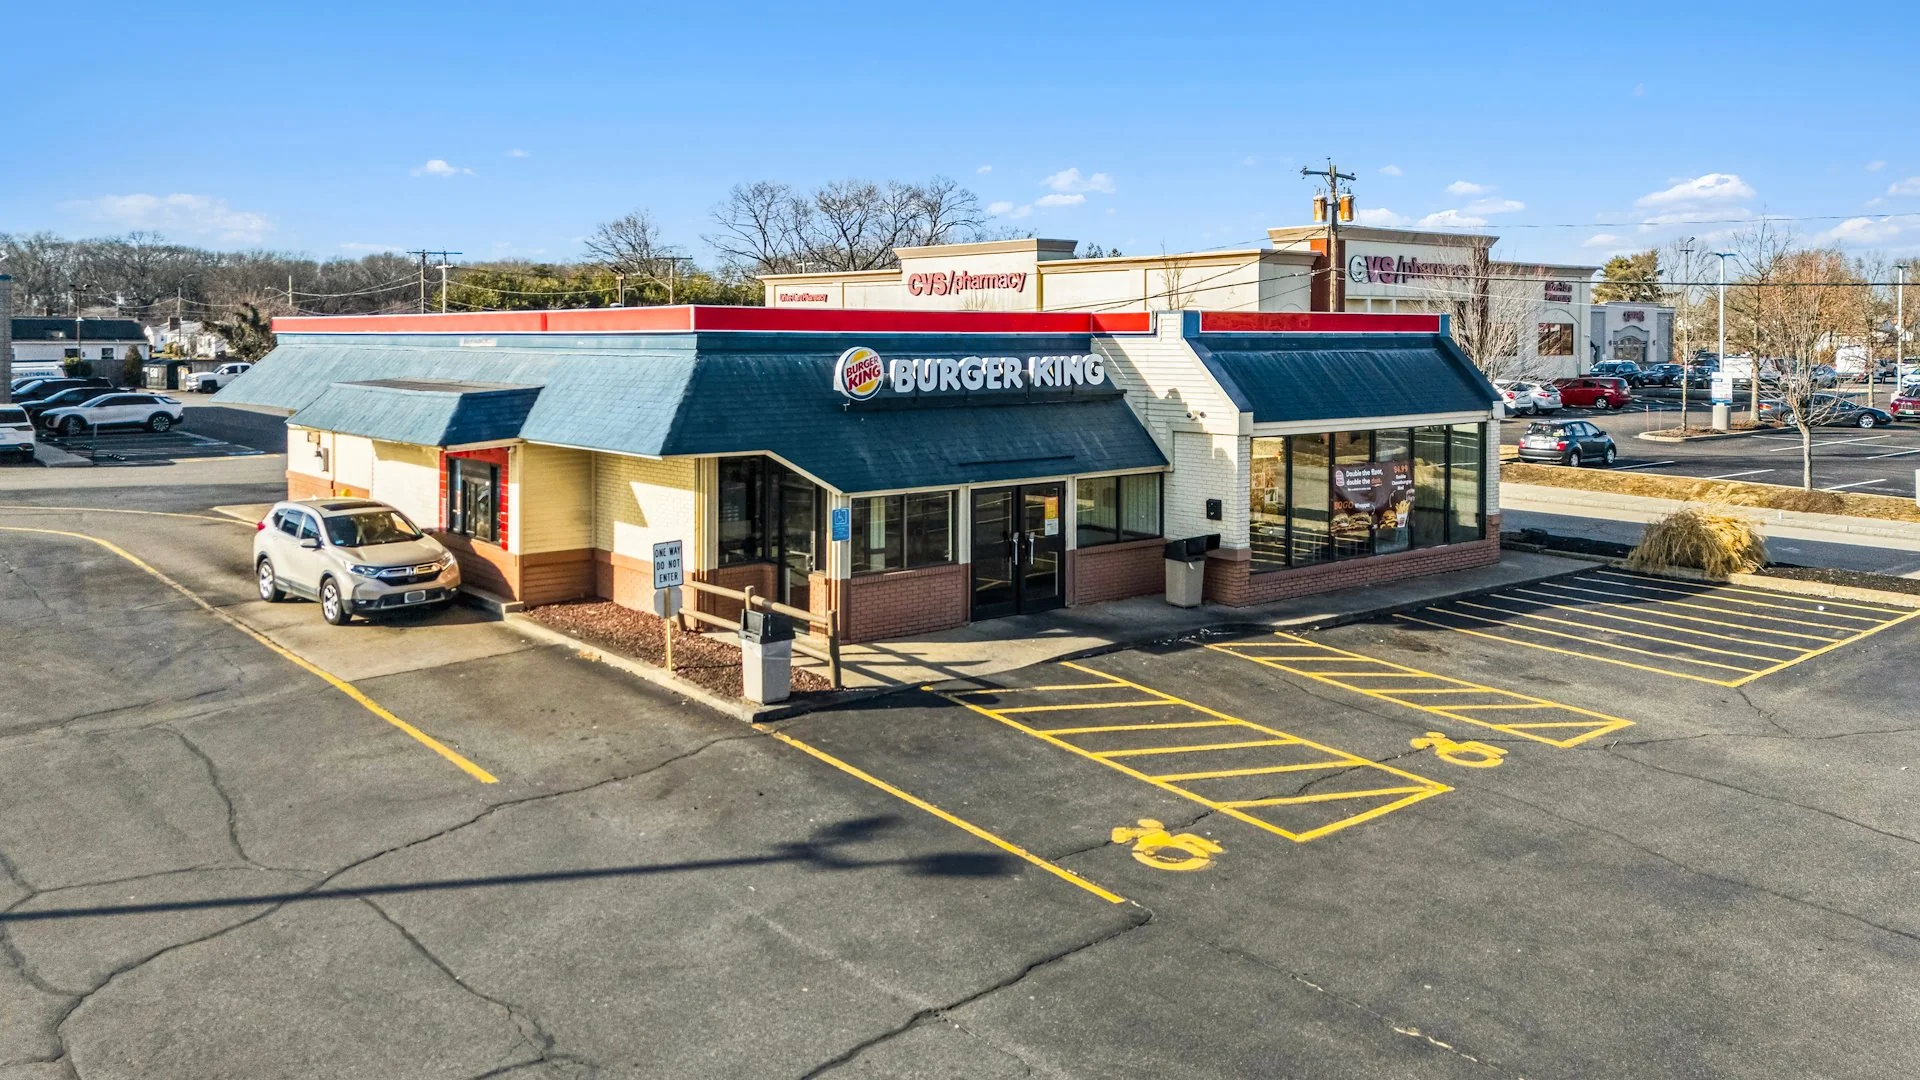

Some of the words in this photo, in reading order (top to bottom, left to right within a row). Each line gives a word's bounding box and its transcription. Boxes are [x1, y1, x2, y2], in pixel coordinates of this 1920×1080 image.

[908, 270, 1027, 297] CVS/pharmacy
[846, 355, 879, 378] BURGER
[848, 365, 881, 391] KING
[890, 356, 1024, 393] BURGER
[1030, 354, 1105, 388] KING
[655, 547, 667, 558] ONE
[669, 546, 681, 556] WAY
[656, 561, 665, 571] DO
[668, 558, 680, 569] NOT
[659, 571, 679, 583] ENTER
